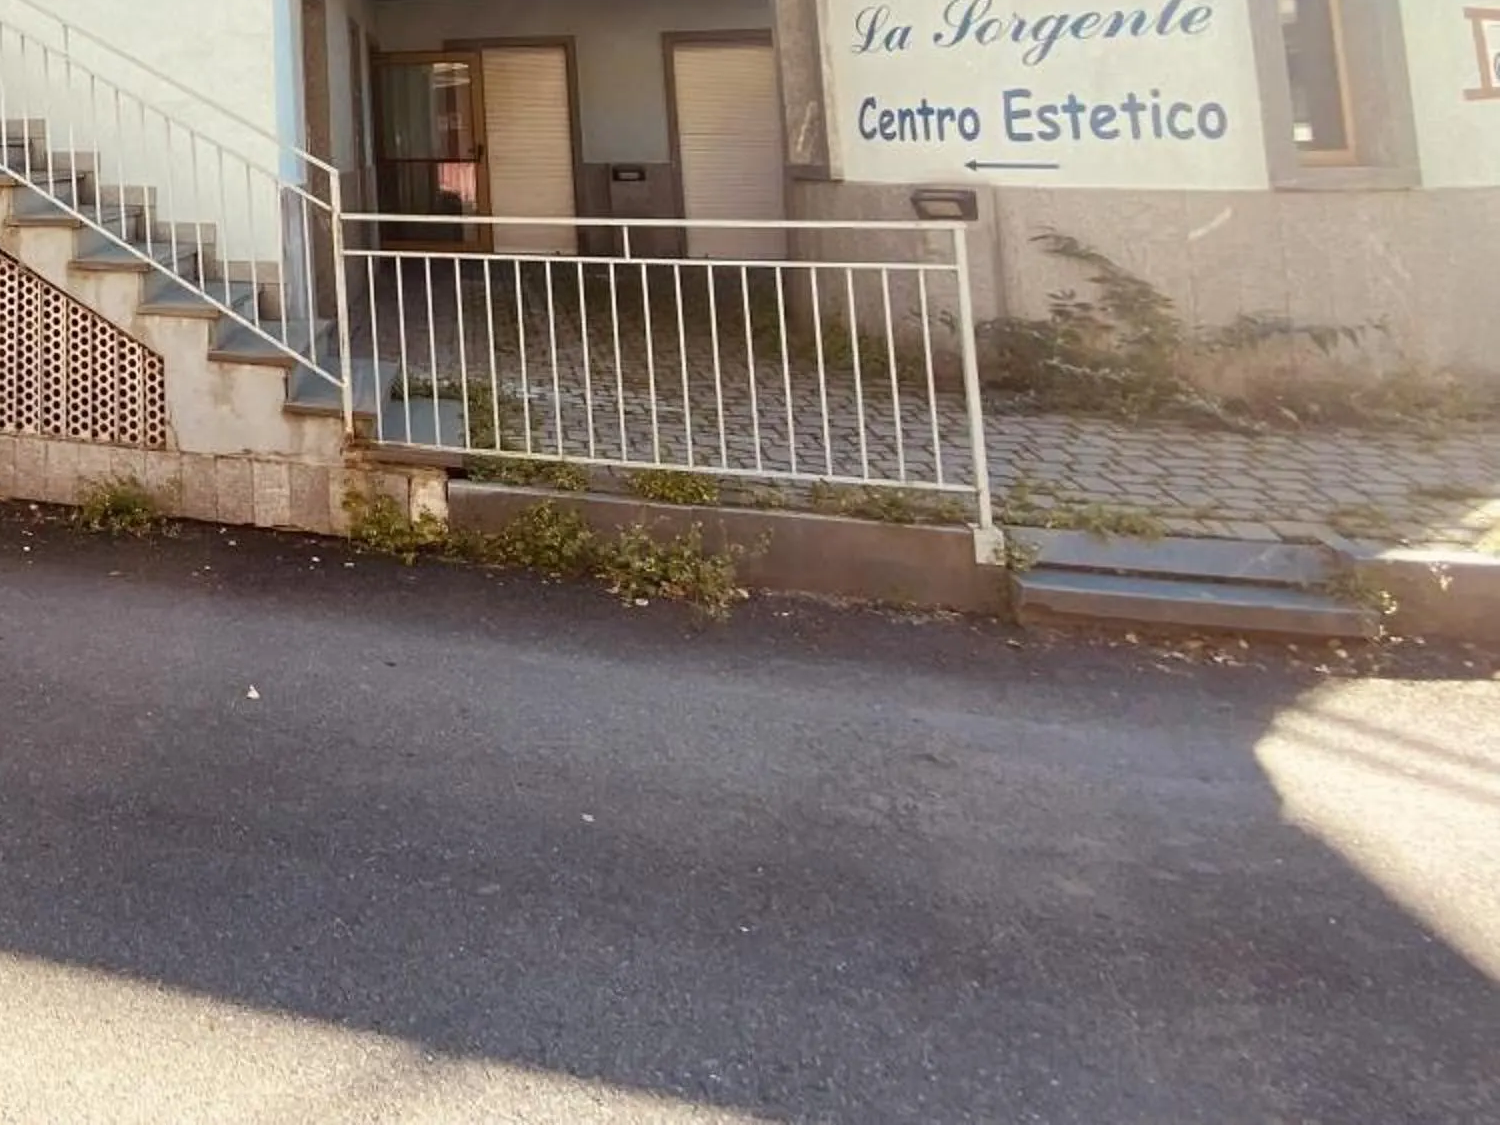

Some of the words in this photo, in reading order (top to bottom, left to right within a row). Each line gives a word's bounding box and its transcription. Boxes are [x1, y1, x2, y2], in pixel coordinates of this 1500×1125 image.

[851, 5, 911, 55] La
[858, 96, 981, 142] Centro
[1002, 88, 1228, 142] Estetico
